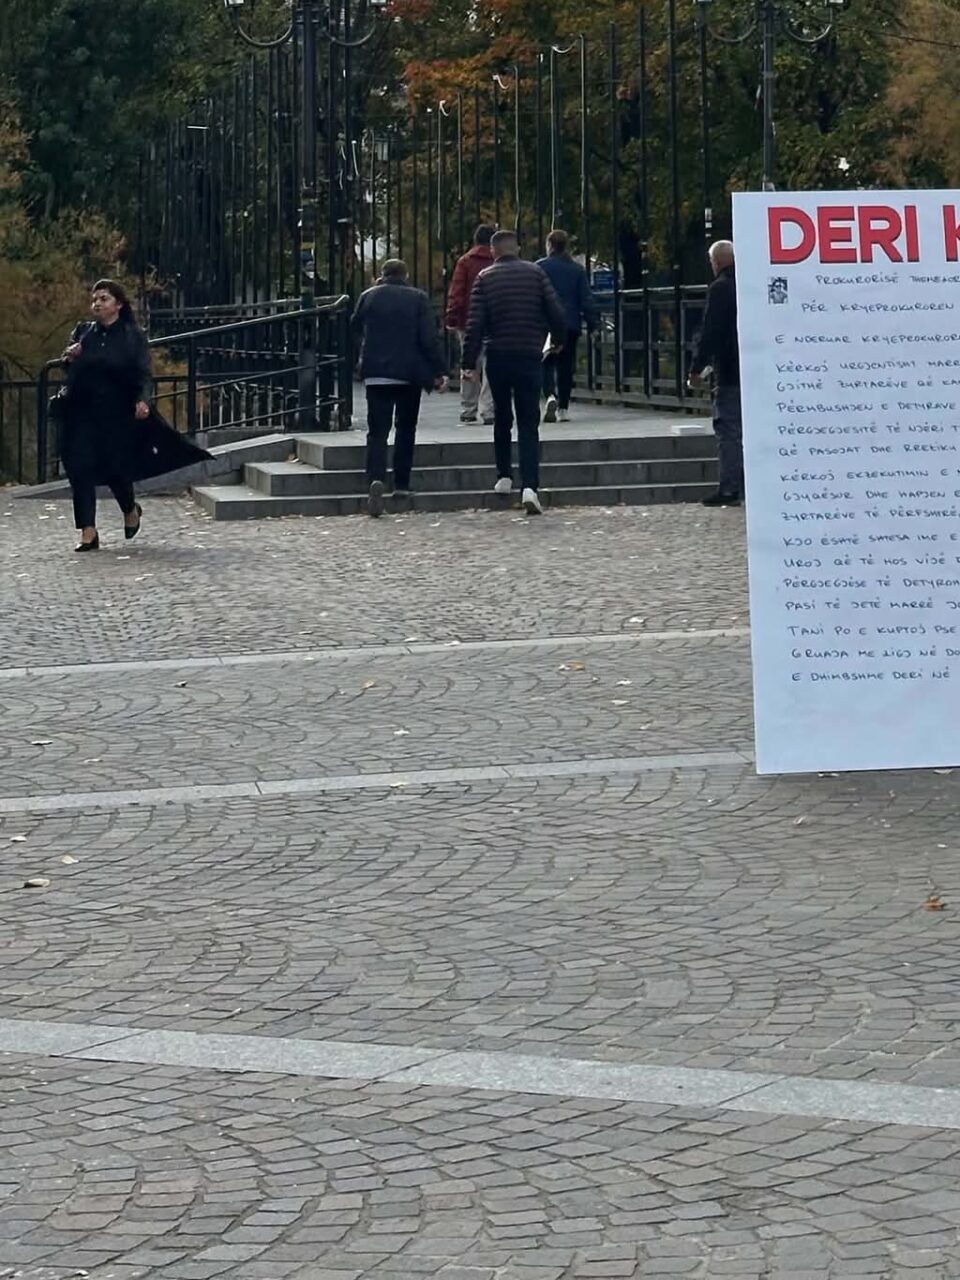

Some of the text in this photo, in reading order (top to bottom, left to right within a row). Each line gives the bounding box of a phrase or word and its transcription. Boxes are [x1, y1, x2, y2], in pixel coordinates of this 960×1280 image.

[767, 204, 920, 265] DERI
[775, 334, 784, 344] E
[881, 403, 889, 411] E
[940, 469, 949, 477] E
[953, 490, 960, 498] E
[949, 532, 958, 541] E
[858, 626, 867, 635] E
[791, 672, 801, 682] E
